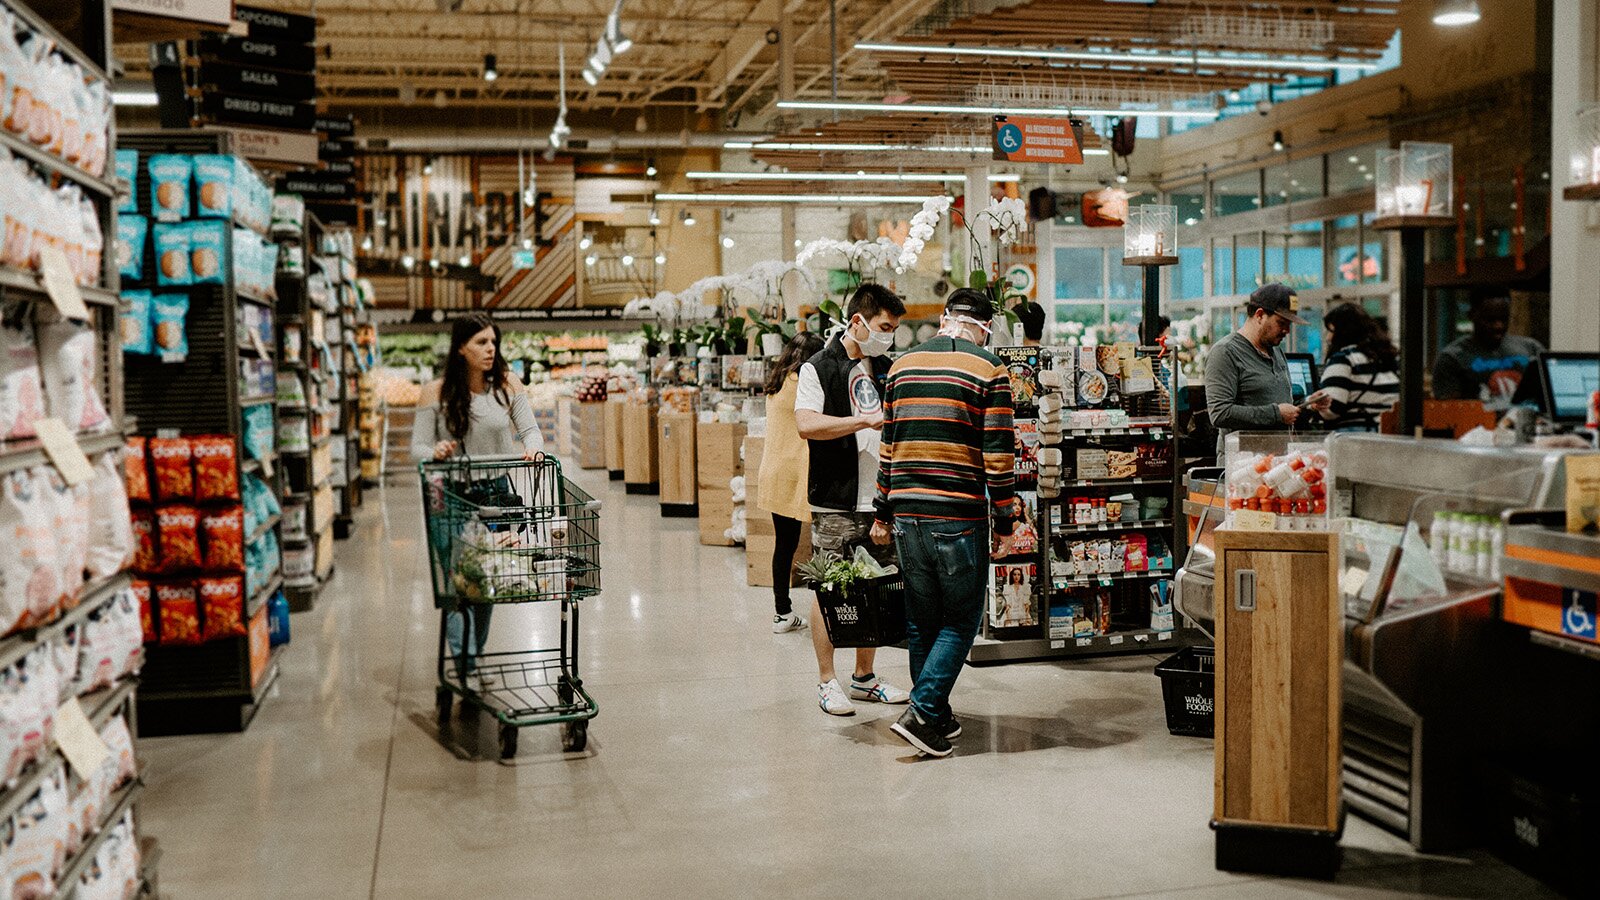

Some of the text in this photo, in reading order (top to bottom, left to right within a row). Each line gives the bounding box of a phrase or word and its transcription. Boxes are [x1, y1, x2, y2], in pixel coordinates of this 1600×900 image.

[242, 41, 277, 57] CHIPS
[241, 70, 278, 86] SALSA
[224, 97, 295, 116] DRIED FRUIT
[1421, 178, 1433, 214] 7
[998, 349, 1038, 357] PLANT-BASED
[152, 445, 191, 459] dang
[193, 445, 232, 458] dang
[1117, 454, 1132, 463] dang
[1117, 466, 1132, 475] dang
[159, 513, 195, 528] dang
[203, 516, 239, 530] dang
[157, 586, 195, 600] dang
[201, 583, 238, 598] dang
[834, 605, 857, 614] WHOLE
[837, 613, 859, 621] FOODS
[1184, 695, 1214, 705] WHOLE
[1186, 703, 1214, 712] FOODS
